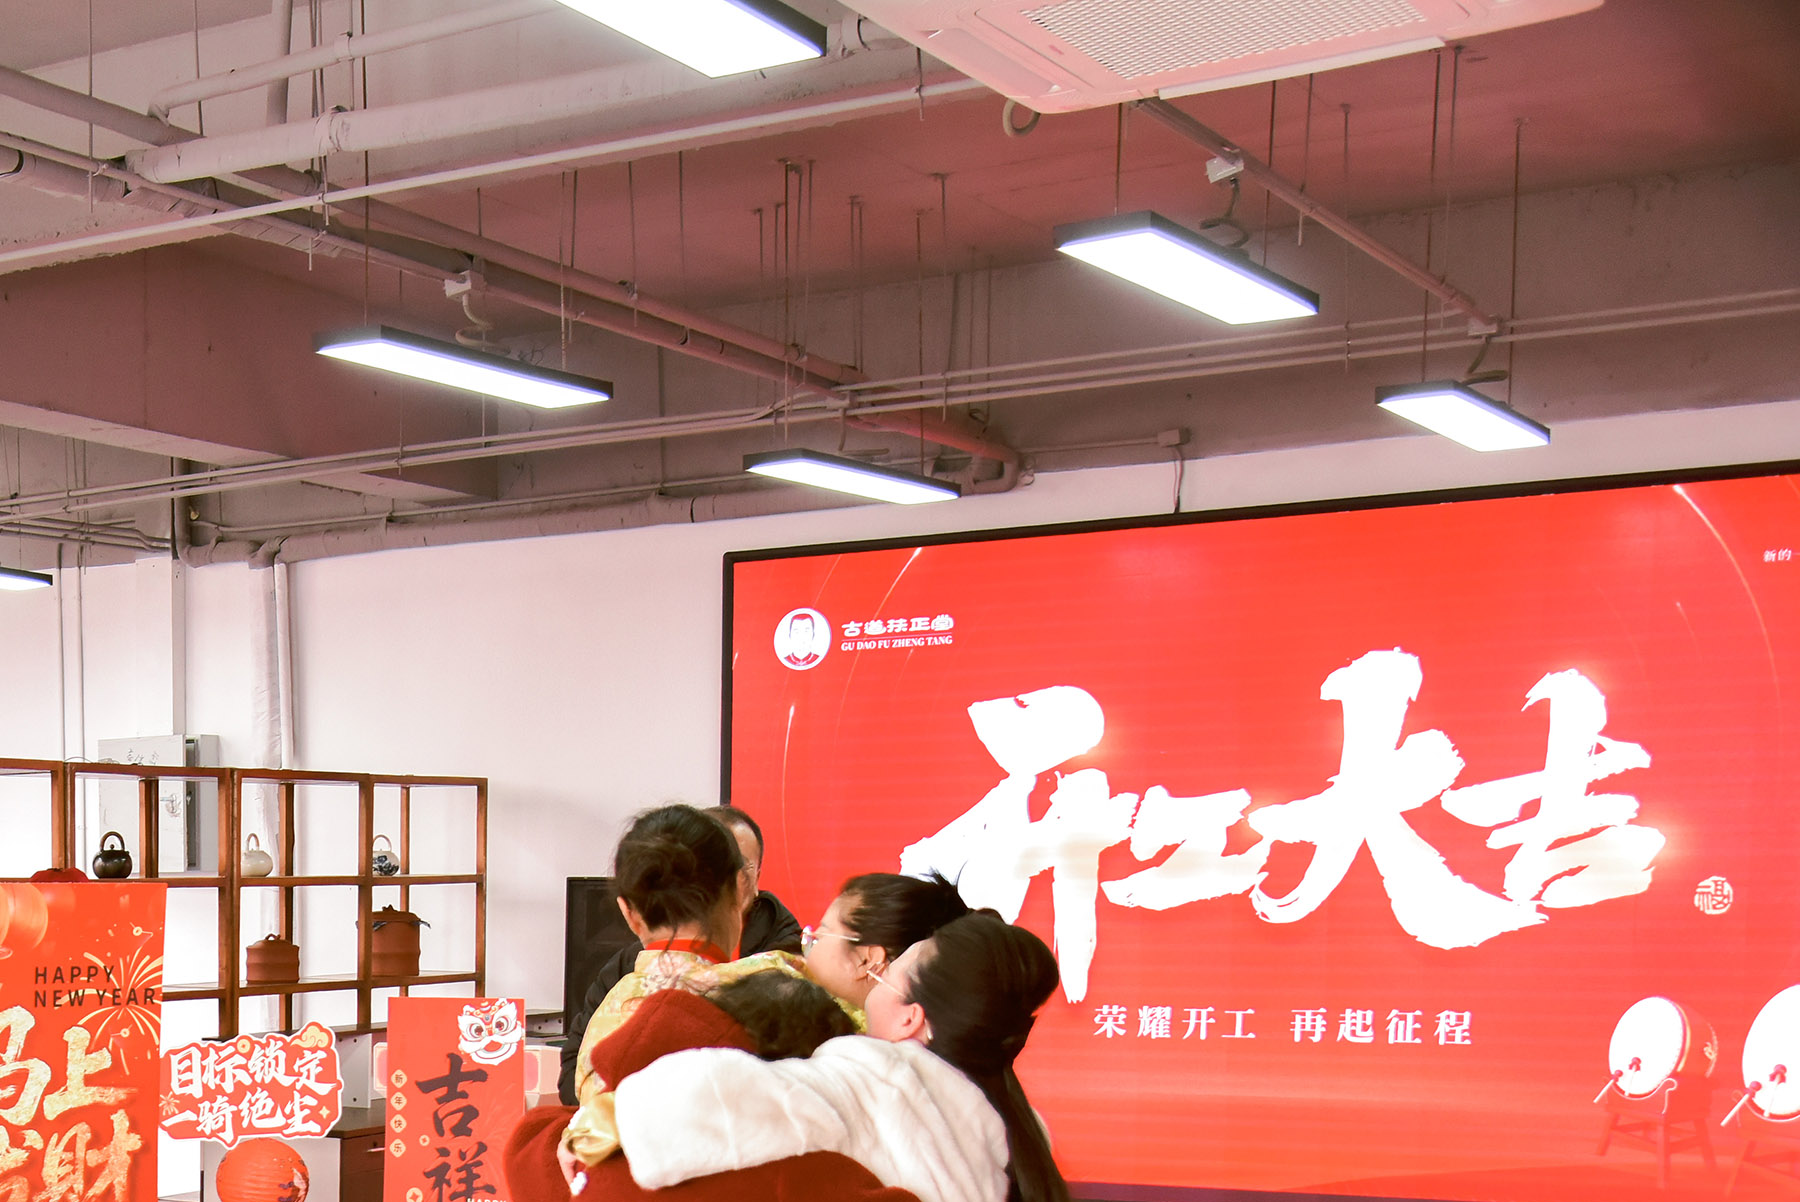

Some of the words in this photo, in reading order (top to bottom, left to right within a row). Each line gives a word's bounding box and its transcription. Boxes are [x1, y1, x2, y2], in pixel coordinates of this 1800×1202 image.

[841, 641, 855, 651] GU
[856, 640, 877, 650] DAO
[878, 639, 891, 649] FU
[892, 637, 925, 648] ZHENG
[925, 635, 953, 646] TANG
[899, 647, 1666, 1003] 开工大吉
[35, 965, 115, 984] HAPPY
[34, 989, 86, 1007] NEW
[96, 987, 156, 1006] YEAR
[1093, 1004, 1256, 1040] 荣耀开工
[1289, 1007, 1472, 1045] 再起征程
[170, 1039, 337, 1098] 目标锁定
[162, 1087, 322, 1144] 一骑绝尘
